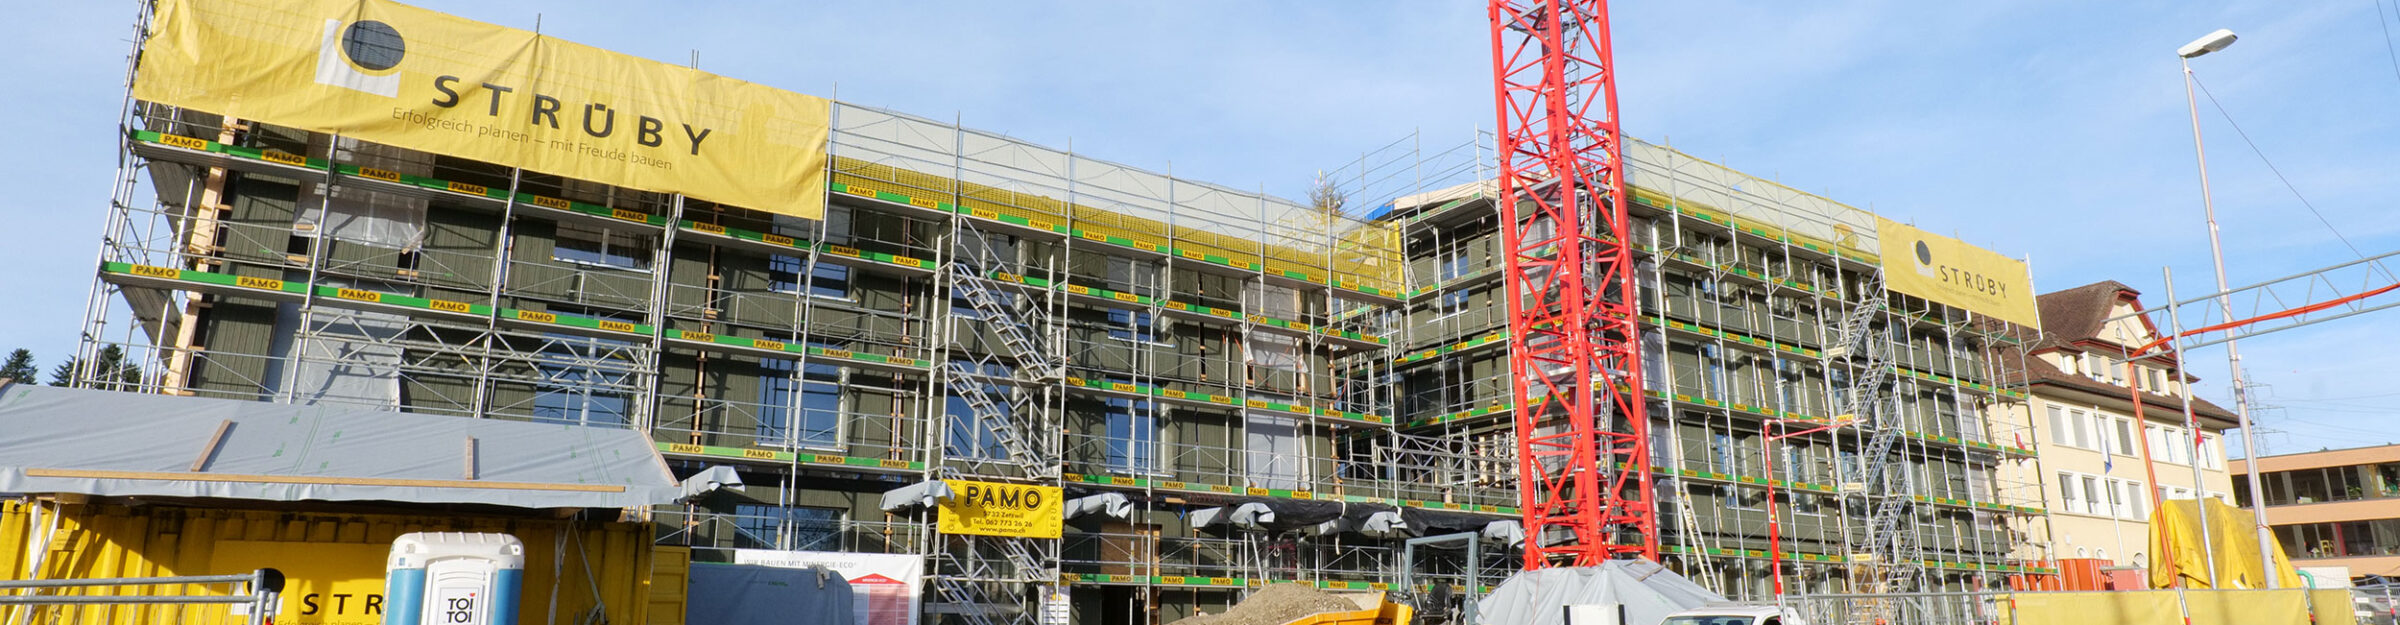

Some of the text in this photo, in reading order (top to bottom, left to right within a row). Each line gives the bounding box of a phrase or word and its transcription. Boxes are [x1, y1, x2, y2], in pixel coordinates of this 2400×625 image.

[432, 75, 711, 156] STRÜBY
[164, 135, 204, 148] PAMO
[392, 107, 472, 133] Erfolgreich
[478, 124, 528, 144] planen
[551, 138, 573, 152] mit
[579, 144, 626, 162] Freude
[632, 152, 672, 171] bauen
[265, 152, 302, 164] PAMO
[362, 168, 396, 180] PAMO
[452, 182, 484, 194] PAMO
[849, 186, 874, 196] PAMO
[537, 197, 568, 208] PAMO
[912, 199, 936, 208] PAMO
[616, 210, 644, 222] PAMO
[974, 209, 996, 219] PAMO
[696, 223, 724, 234] PAMO
[1030, 221, 1052, 230] PAMO
[765, 235, 792, 245] PAMO
[1084, 232, 1105, 240] PAMO
[1136, 241, 1155, 250] PAMO
[832, 247, 858, 256] PAMO
[1184, 251, 1203, 260] PAMO
[895, 257, 918, 266] PAMO
[1230, 260, 1248, 268] PAMO
[136, 266, 176, 278] PAMO
[1000, 274, 1022, 282] PAMO
[241, 278, 279, 289] PAMO
[341, 290, 376, 301] PAMO
[1117, 294, 1137, 302] PAMO
[432, 300, 466, 312] PAMO
[522, 312, 552, 322] PAMO
[1212, 309, 1229, 317] PAMO
[602, 322, 632, 331] PAMO
[684, 332, 712, 342] PAMO
[756, 341, 782, 350] PAMO
[825, 350, 850, 358] PAMO
[888, 358, 912, 366] PAMO
[1067, 378, 1084, 386] AMO
[1114, 384, 1134, 392] PAMO
[1165, 390, 1184, 398] PAMO
[672, 444, 701, 453] PAMO
[746, 450, 773, 458] PAMO
[817, 455, 843, 464] PAMO
[882, 460, 907, 468] PAMO
[964, 484, 1042, 511] PAMO
[302, 593, 384, 615] STR
[448, 596, 474, 610] TOI
[446, 610, 472, 624] TOI
